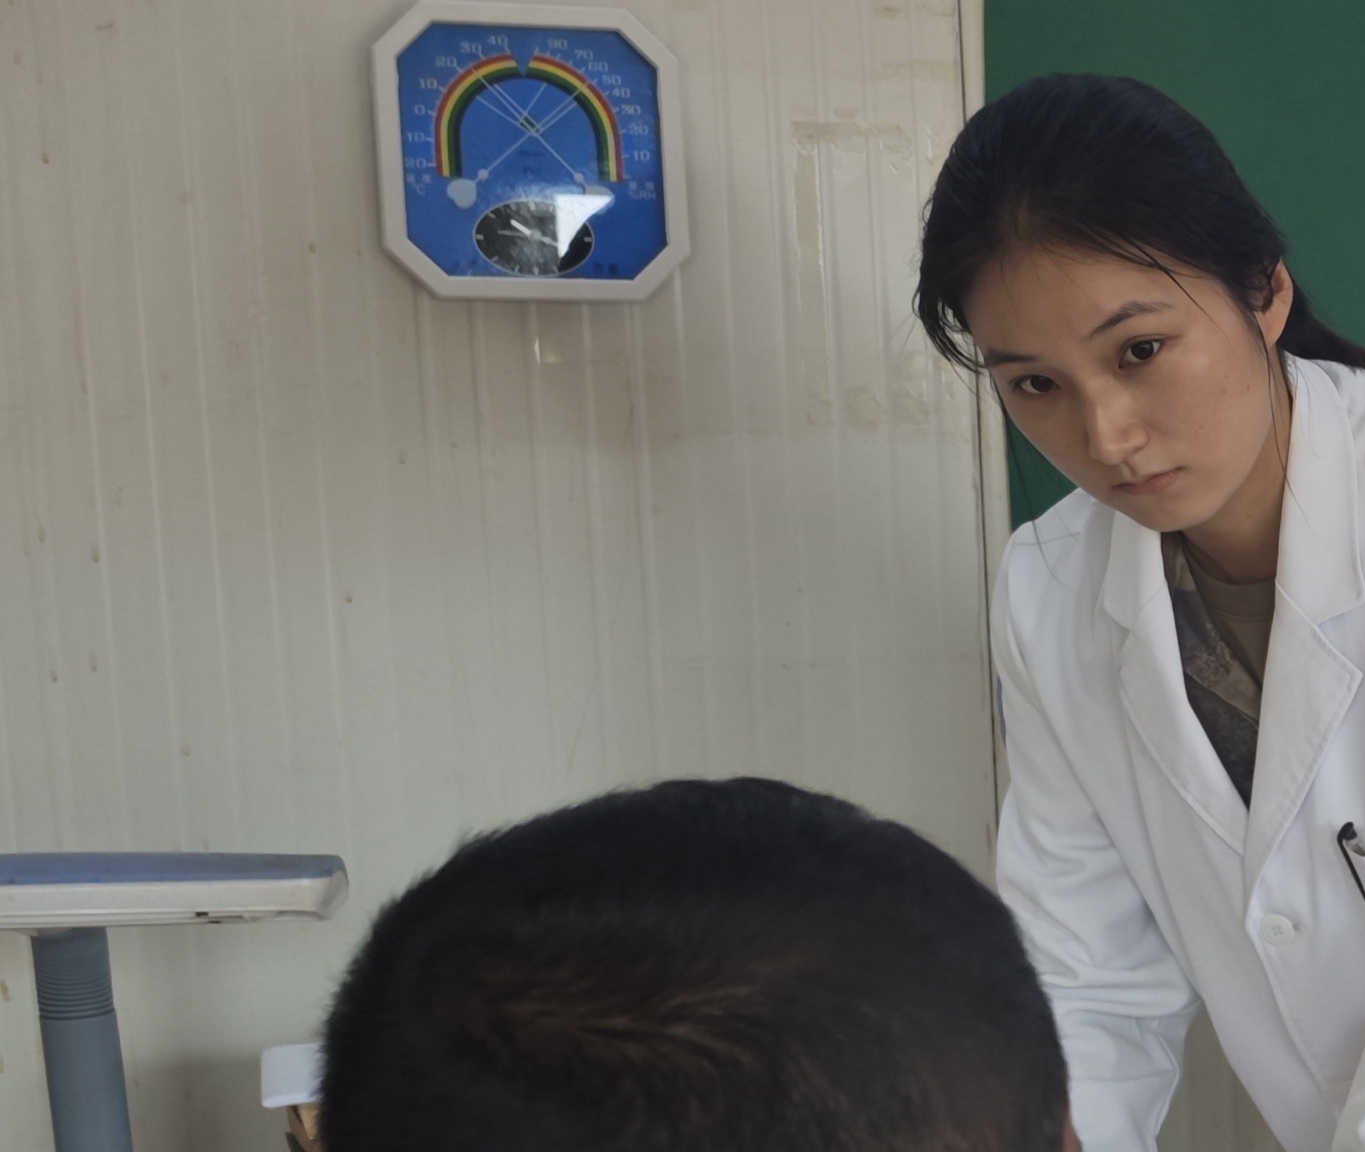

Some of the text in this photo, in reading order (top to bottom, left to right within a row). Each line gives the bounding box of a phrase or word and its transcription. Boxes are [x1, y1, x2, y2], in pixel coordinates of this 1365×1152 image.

[487, 35, 508, 47] 40
[460, 42, 481, 53] 30
[575, 50, 593, 60] 70
[435, 57, 457, 68] 20
[419, 78, 437, 89] 10
[602, 75, 621, 86] 50
[612, 88, 630, 98] 40
[414, 104, 425, 115] 0
[621, 105, 641, 115] 30
[628, 124, 648, 135] 20
[633, 150, 650, 161] 10
